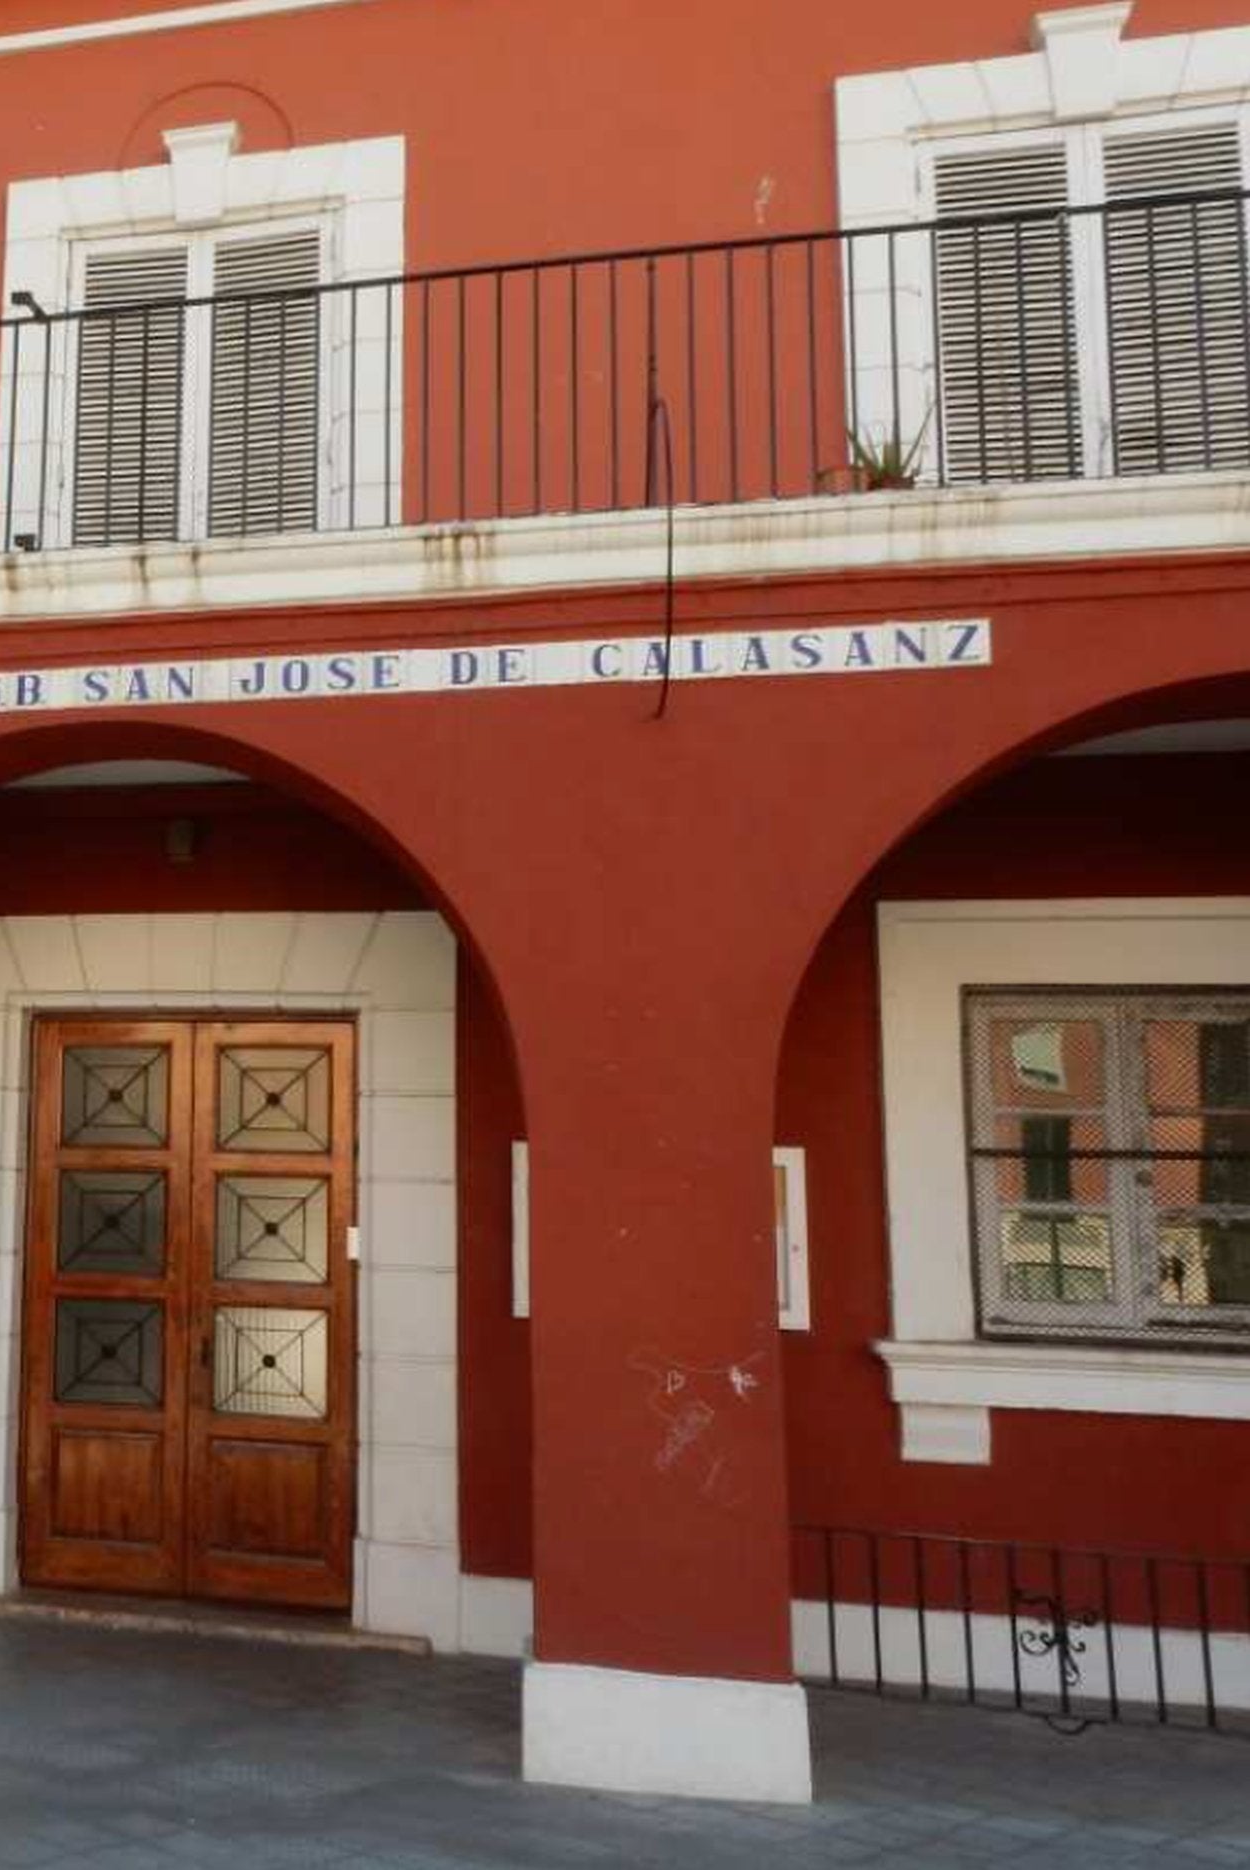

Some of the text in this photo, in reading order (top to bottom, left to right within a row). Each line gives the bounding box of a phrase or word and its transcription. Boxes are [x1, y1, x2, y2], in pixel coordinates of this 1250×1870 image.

[84, 666, 196, 702] SAN
[239, 654, 400, 694] JOSE
[450, 648, 527, 686] DE
[591, 624, 981, 678] CALASANZ
